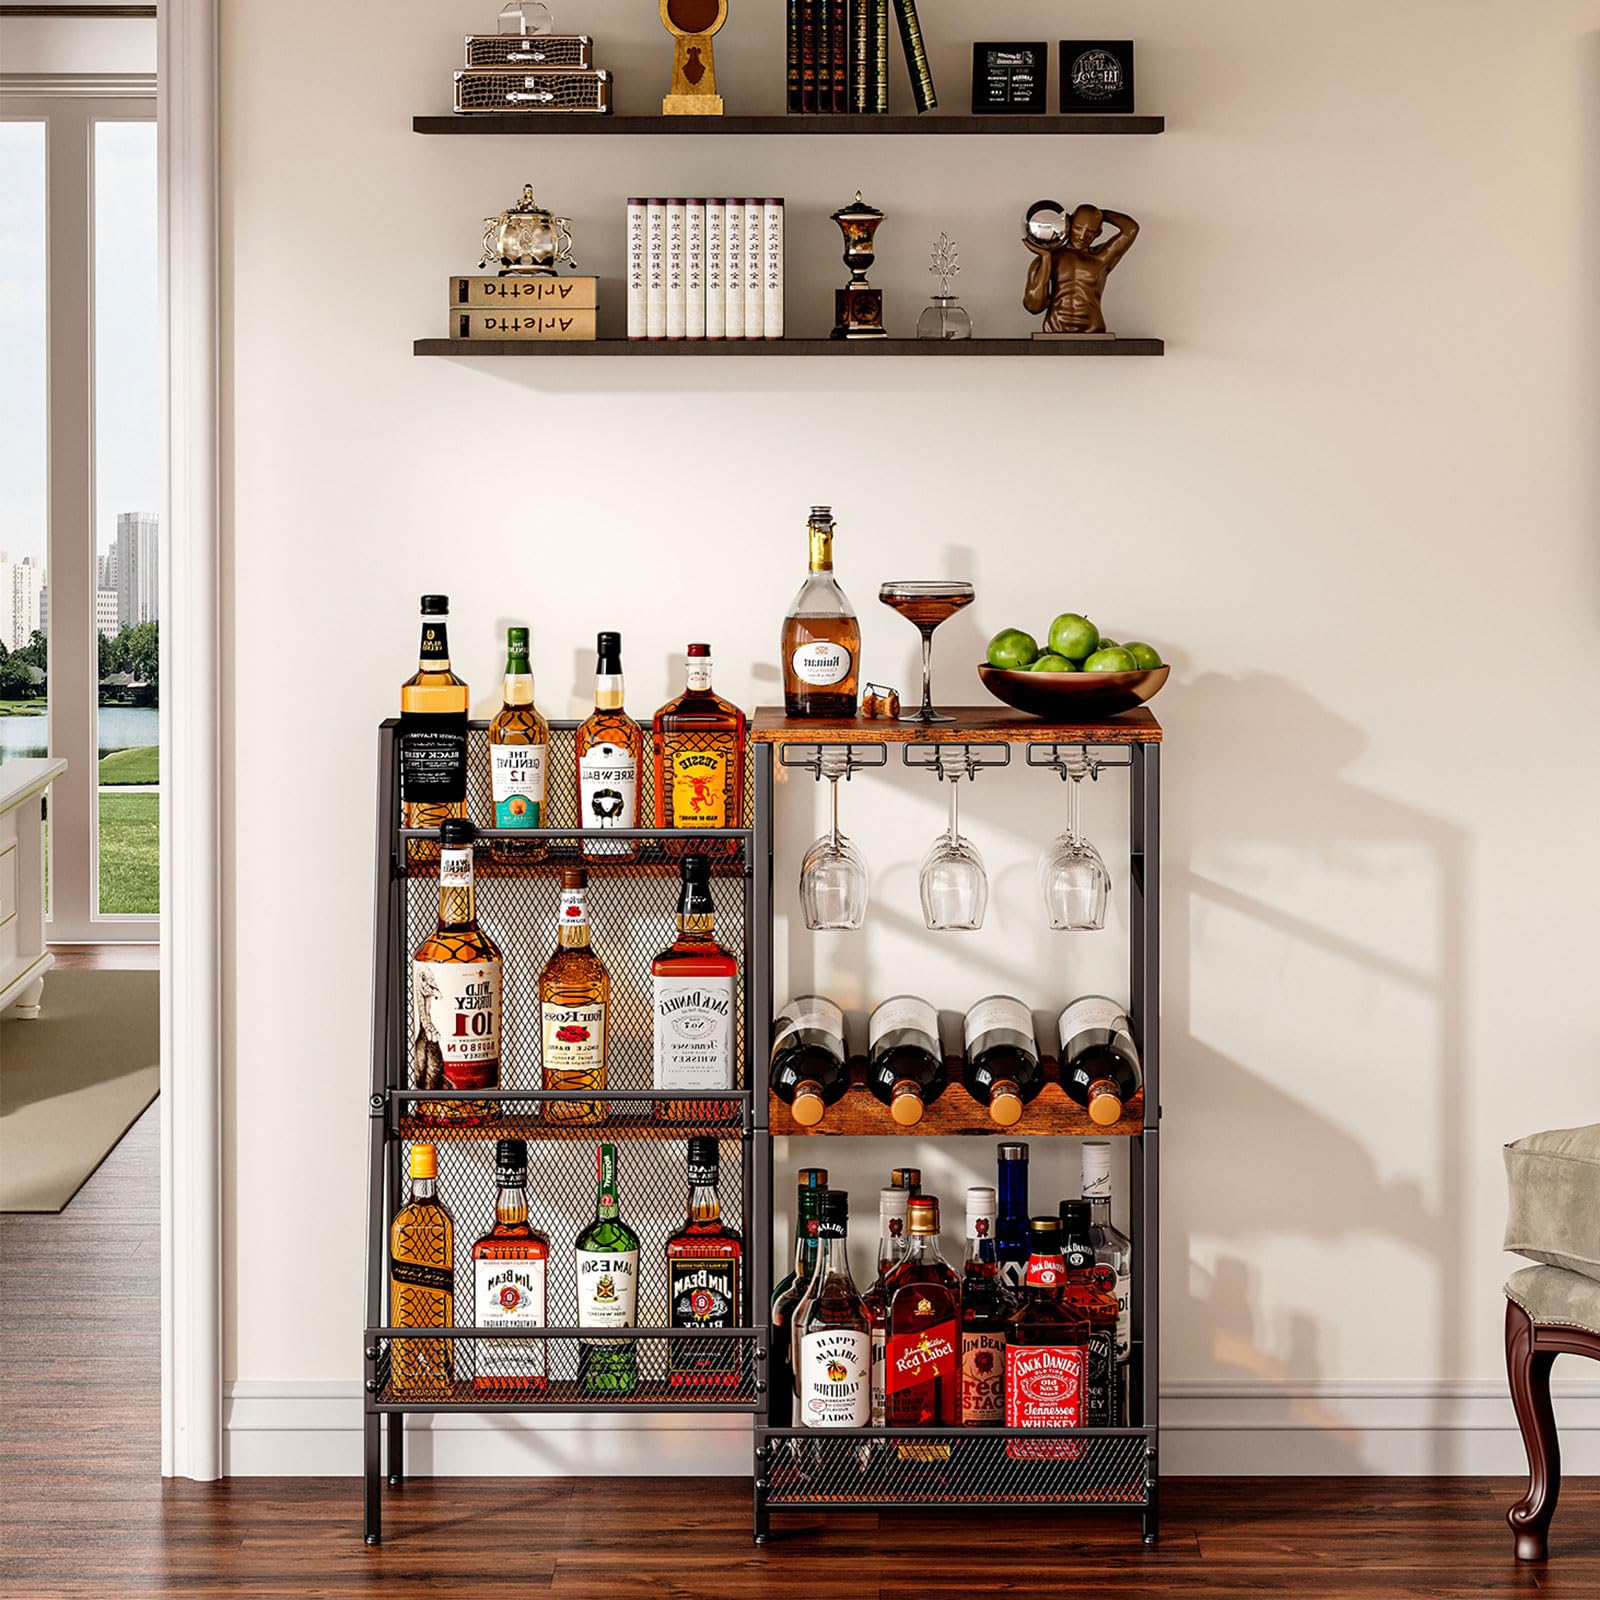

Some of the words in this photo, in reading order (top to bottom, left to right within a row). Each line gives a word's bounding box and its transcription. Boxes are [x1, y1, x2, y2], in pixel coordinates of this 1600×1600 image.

[484, 283, 573, 300] Arletta
[485, 317, 573, 333] Arletta
[816, 1336, 857, 1348] HAPPY
[961, 1339, 978, 1355] JIM
[815, 1349, 860, 1365] MALIBU
[896, 1354, 921, 1372] Red
[921, 1343, 953, 1363] Label
[1017, 1357, 1042, 1377] JACK
[1043, 1352, 1080, 1377] DANIEL'S
[813, 1382, 860, 1397] BIRTHDAY
[963, 1396, 1006, 1410] STAG
[1024, 1402, 1075, 1415] Tennessee
[821, 1413, 855, 1422] JADON
[1021, 1420, 1077, 1428] WHISKEY
